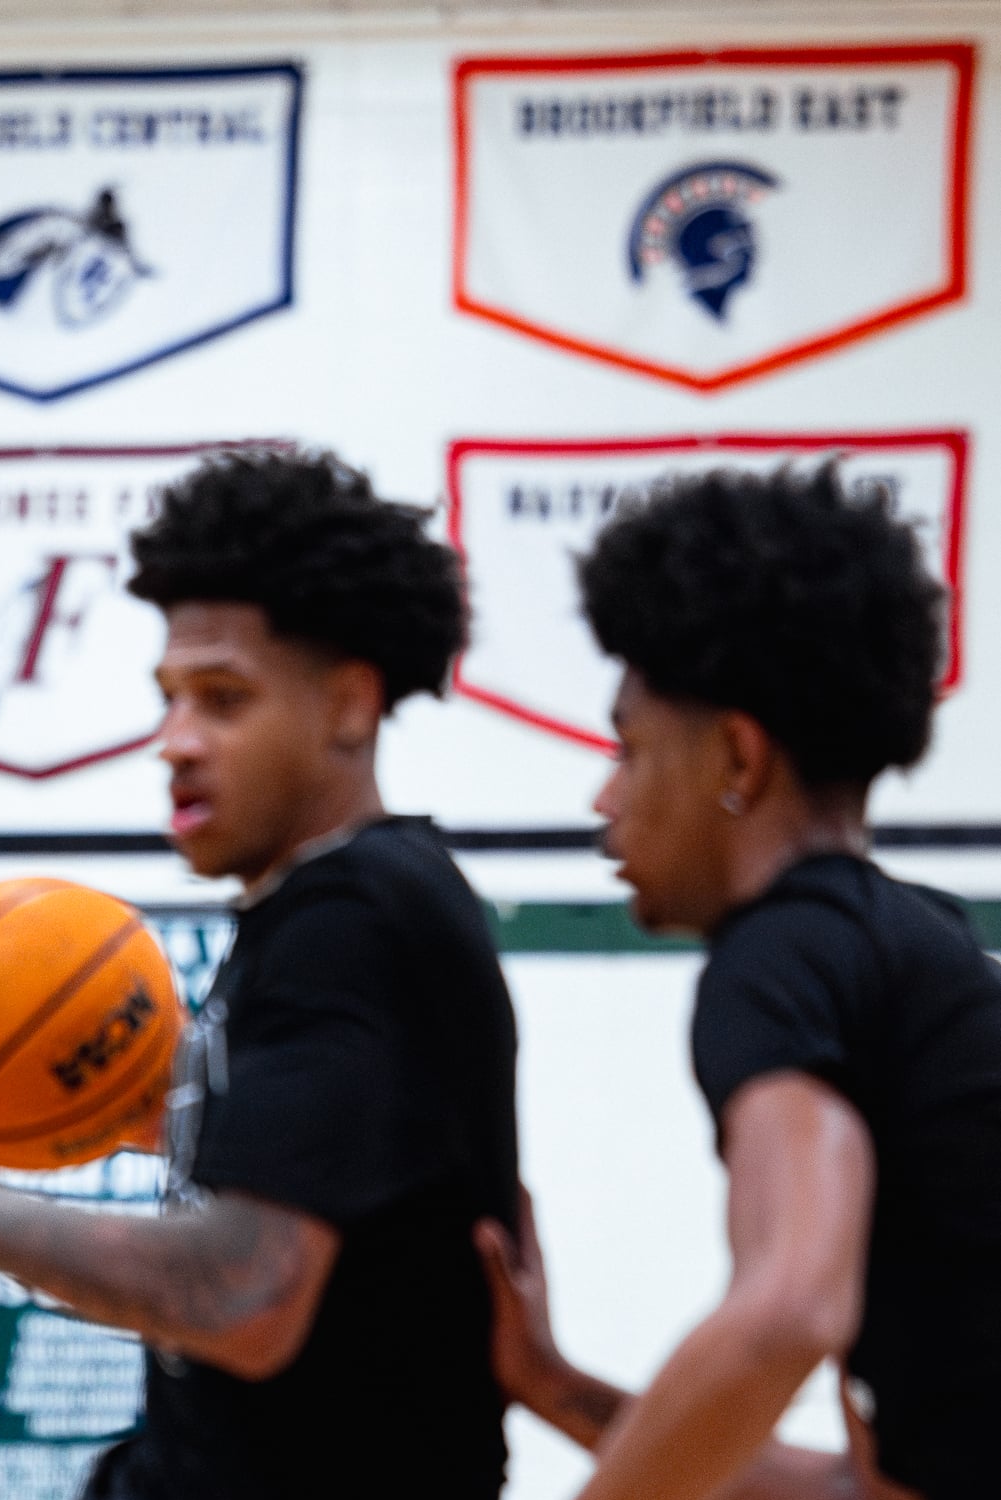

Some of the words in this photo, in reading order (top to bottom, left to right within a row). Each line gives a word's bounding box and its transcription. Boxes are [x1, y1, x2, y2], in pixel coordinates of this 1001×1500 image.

[91, 107, 267, 146] CENTRAL
[517, 86, 777, 137] BROOKFIELD
[793, 84, 904, 132] EAST
